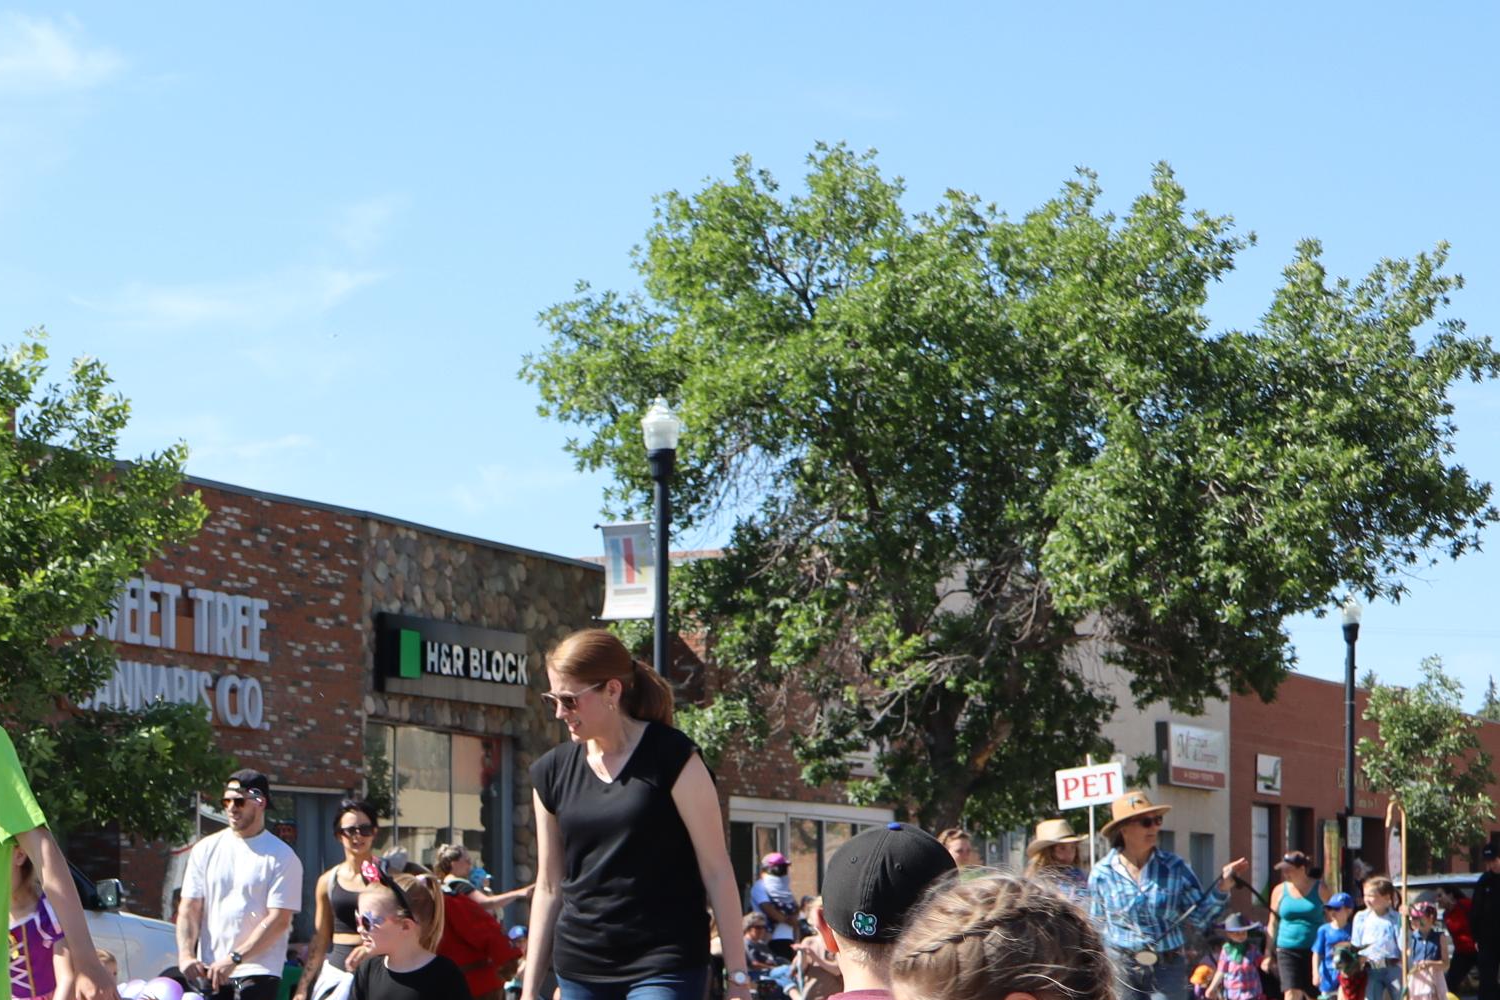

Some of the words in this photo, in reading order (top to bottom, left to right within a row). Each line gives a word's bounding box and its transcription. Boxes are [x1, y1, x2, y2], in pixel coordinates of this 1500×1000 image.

[188, 588, 270, 663] TREE
[426, 640, 465, 677] H&R
[469, 647, 529, 685] BLOCK
[215, 674, 271, 732] CO.
[1062, 771, 1117, 801] PET
